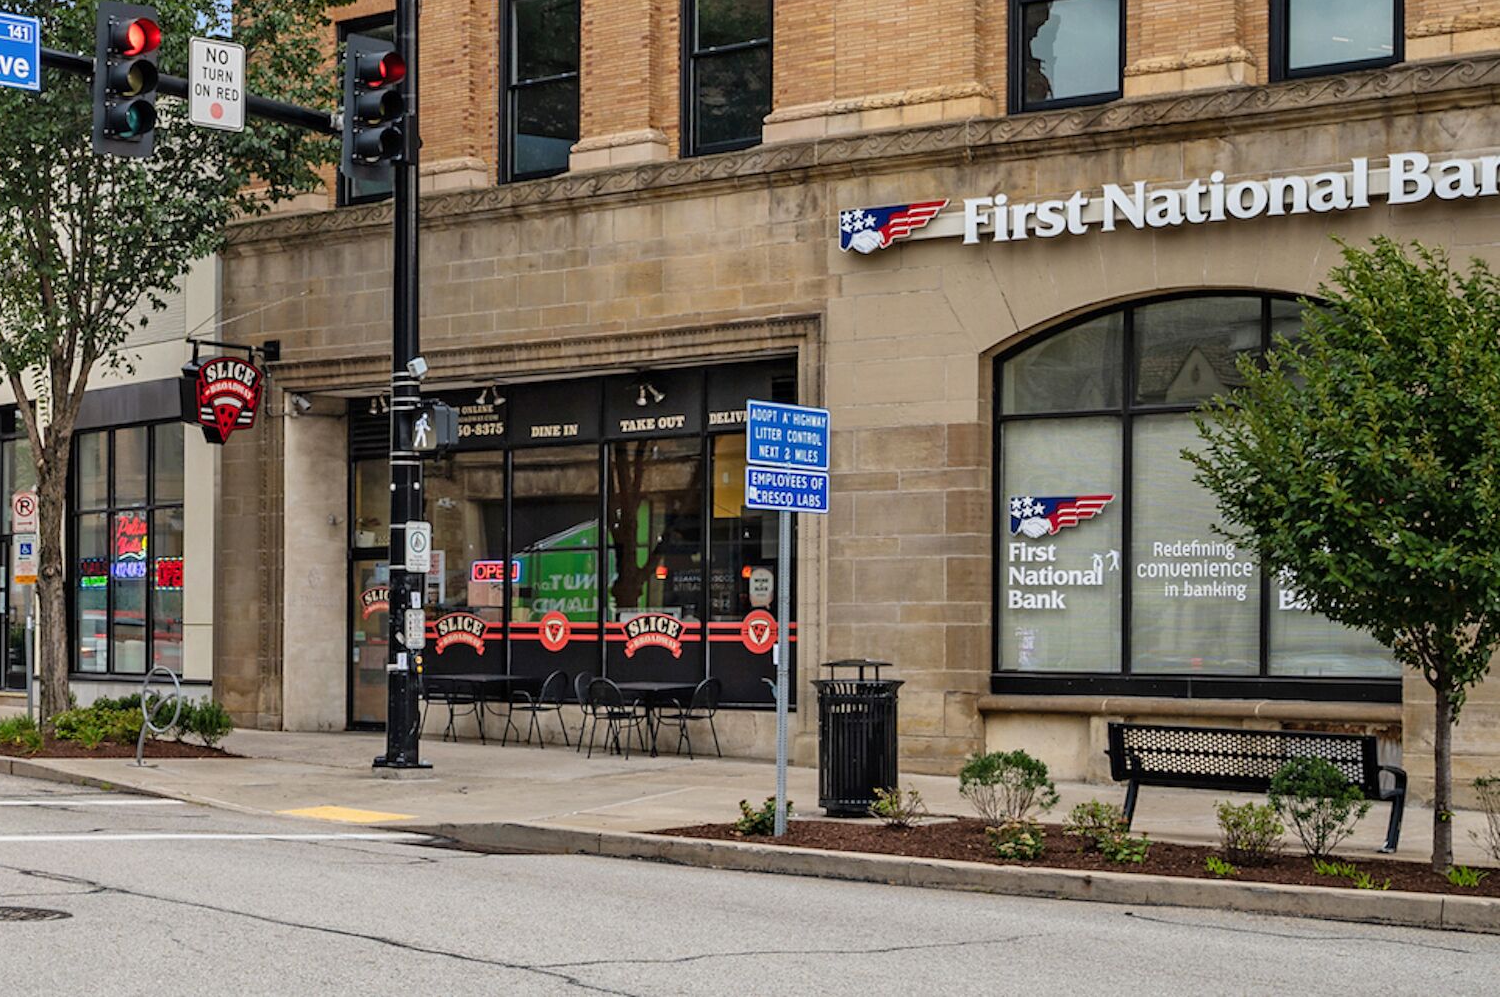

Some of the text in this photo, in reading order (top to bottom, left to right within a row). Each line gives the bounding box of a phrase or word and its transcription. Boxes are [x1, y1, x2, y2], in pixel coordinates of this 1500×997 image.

[7, 24, 29, 41] 141
[206, 47, 228, 65] NO
[202, 66, 233, 83] TURN
[194, 83, 239, 101] ON RED
[962, 190, 1090, 244] First
[1100, 156, 1371, 232] National
[205, 361, 256, 386] SLICE
[620, 415, 685, 432] TAKE OUT
[708, 410, 747, 425] DELIV
[751, 408, 778, 423] ADOPT
[792, 414, 826, 428] HIGHWAY
[531, 424, 579, 437] DINE IN
[755, 427, 822, 447] LITTER CONTROL
[758, 445, 819, 463] NEXT 2 MILES
[751, 473, 824, 490] EMPLOYEES OF
[755, 490, 821, 507] CRESCO LABS
[1007, 542, 1056, 562] First
[1153, 540, 1236, 560] Redefining
[1007, 566, 1104, 587] National
[1136, 560, 1253, 578] convenience
[1007, 589, 1067, 610] Bank
[1164, 580, 1247, 600] in banking
[438, 616, 483, 637] SLICE
[628, 616, 680, 638] SLICE
